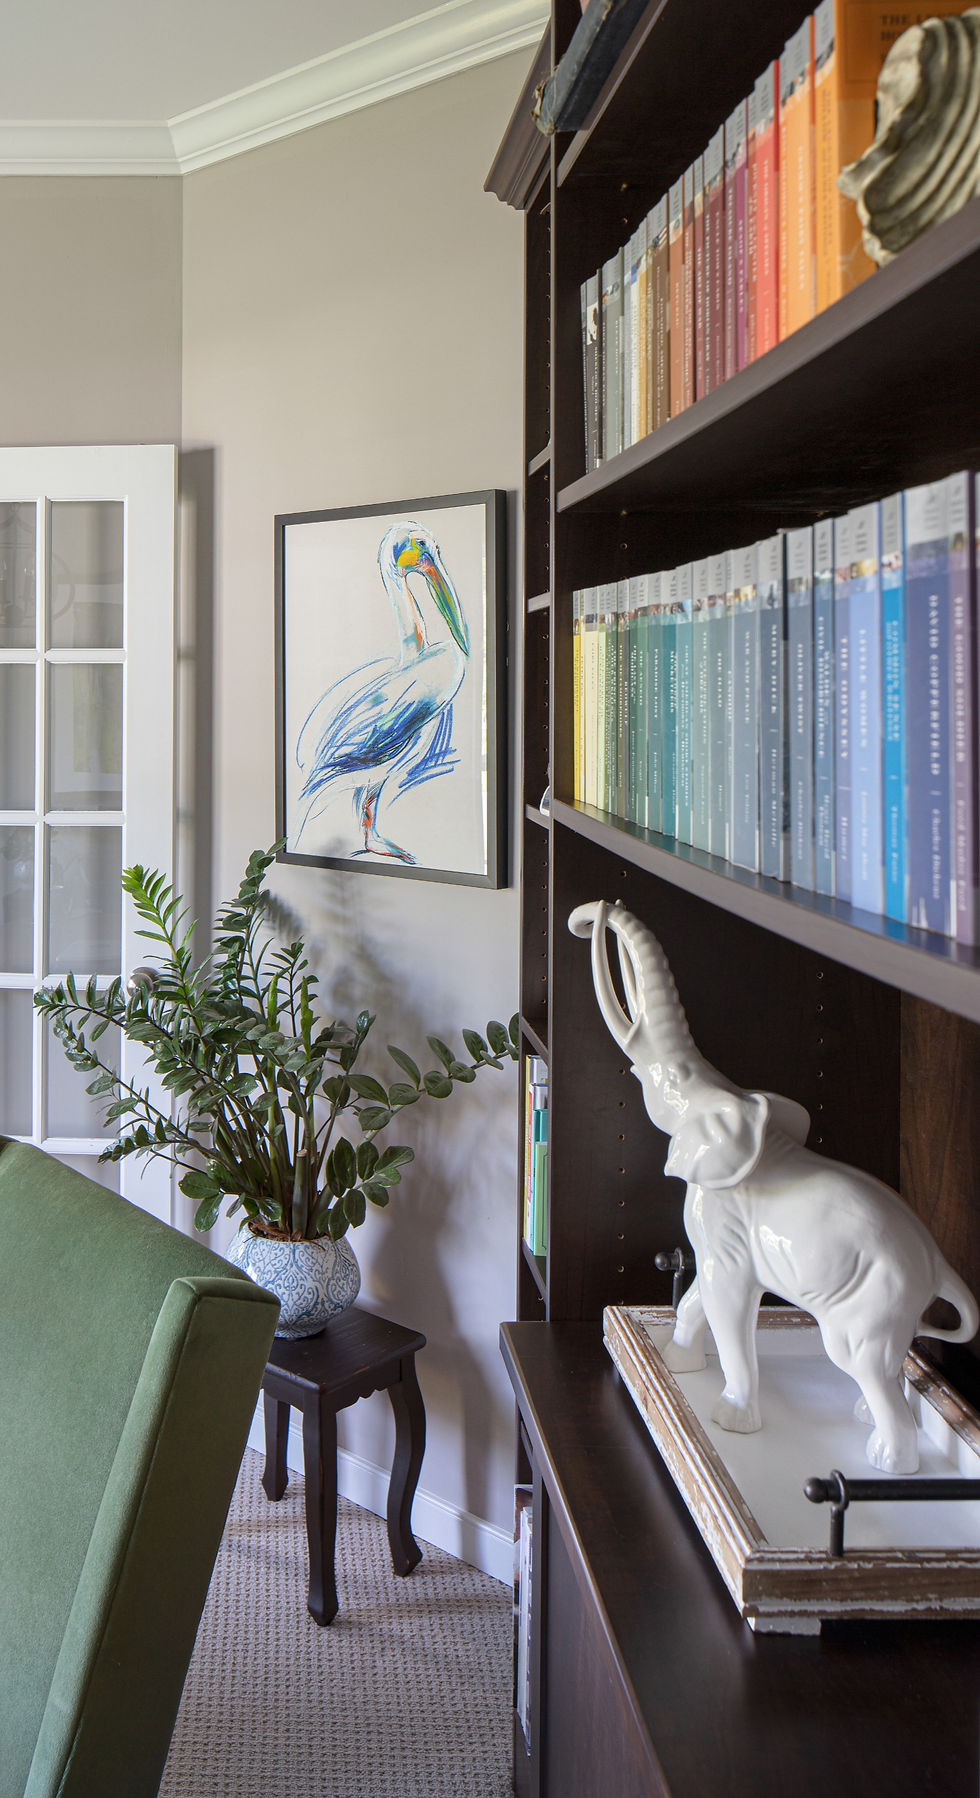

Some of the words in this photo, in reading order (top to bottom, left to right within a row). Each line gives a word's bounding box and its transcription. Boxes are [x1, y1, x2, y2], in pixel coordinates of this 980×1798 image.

[840, 637, 848, 669] THE
[929, 595, 939, 648] DAVID
[840, 680, 848, 758] ODYSSEY
[929, 654, 941, 775] COPPERFIELD
